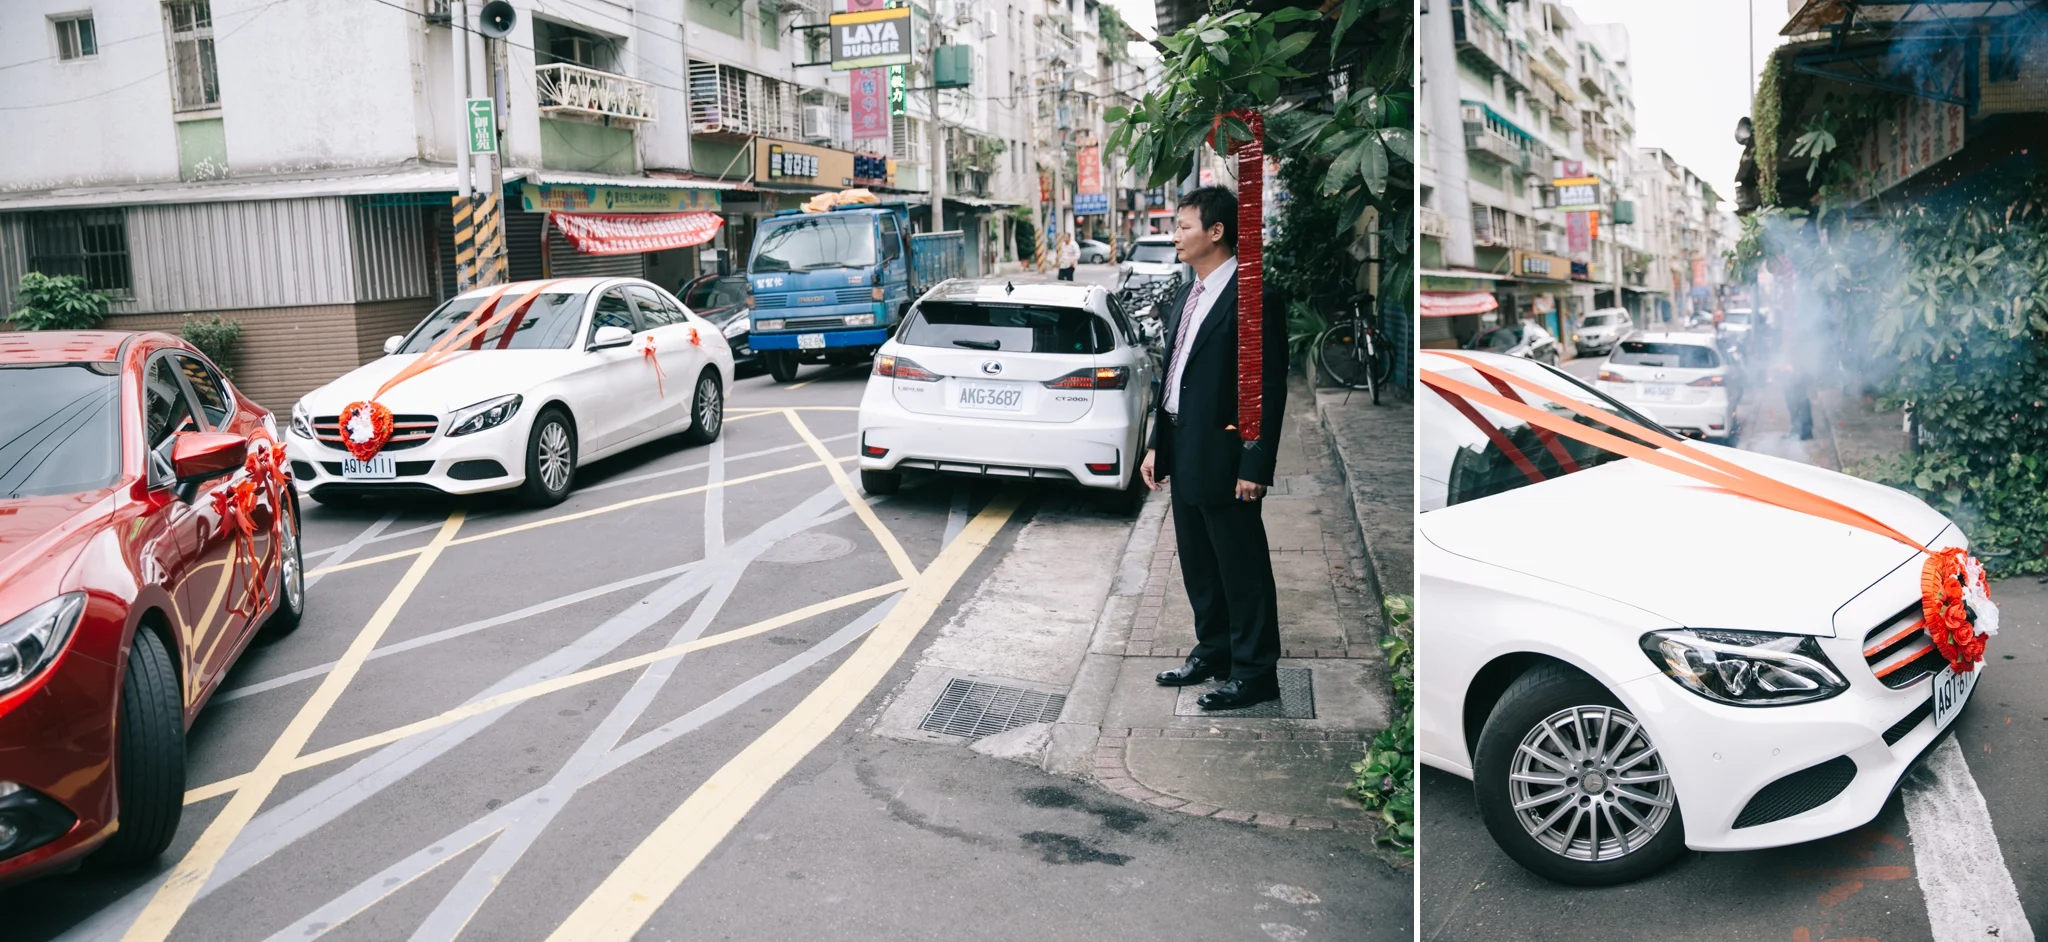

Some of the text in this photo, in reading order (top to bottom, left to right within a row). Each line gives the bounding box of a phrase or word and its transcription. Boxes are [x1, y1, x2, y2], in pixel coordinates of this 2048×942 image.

[842, 22, 899, 45] LAYA
[842, 41, 899, 57] BURGER
[474, 116, 490, 150] 御品苑
[960, 388, 1022, 406] AKG-3687
